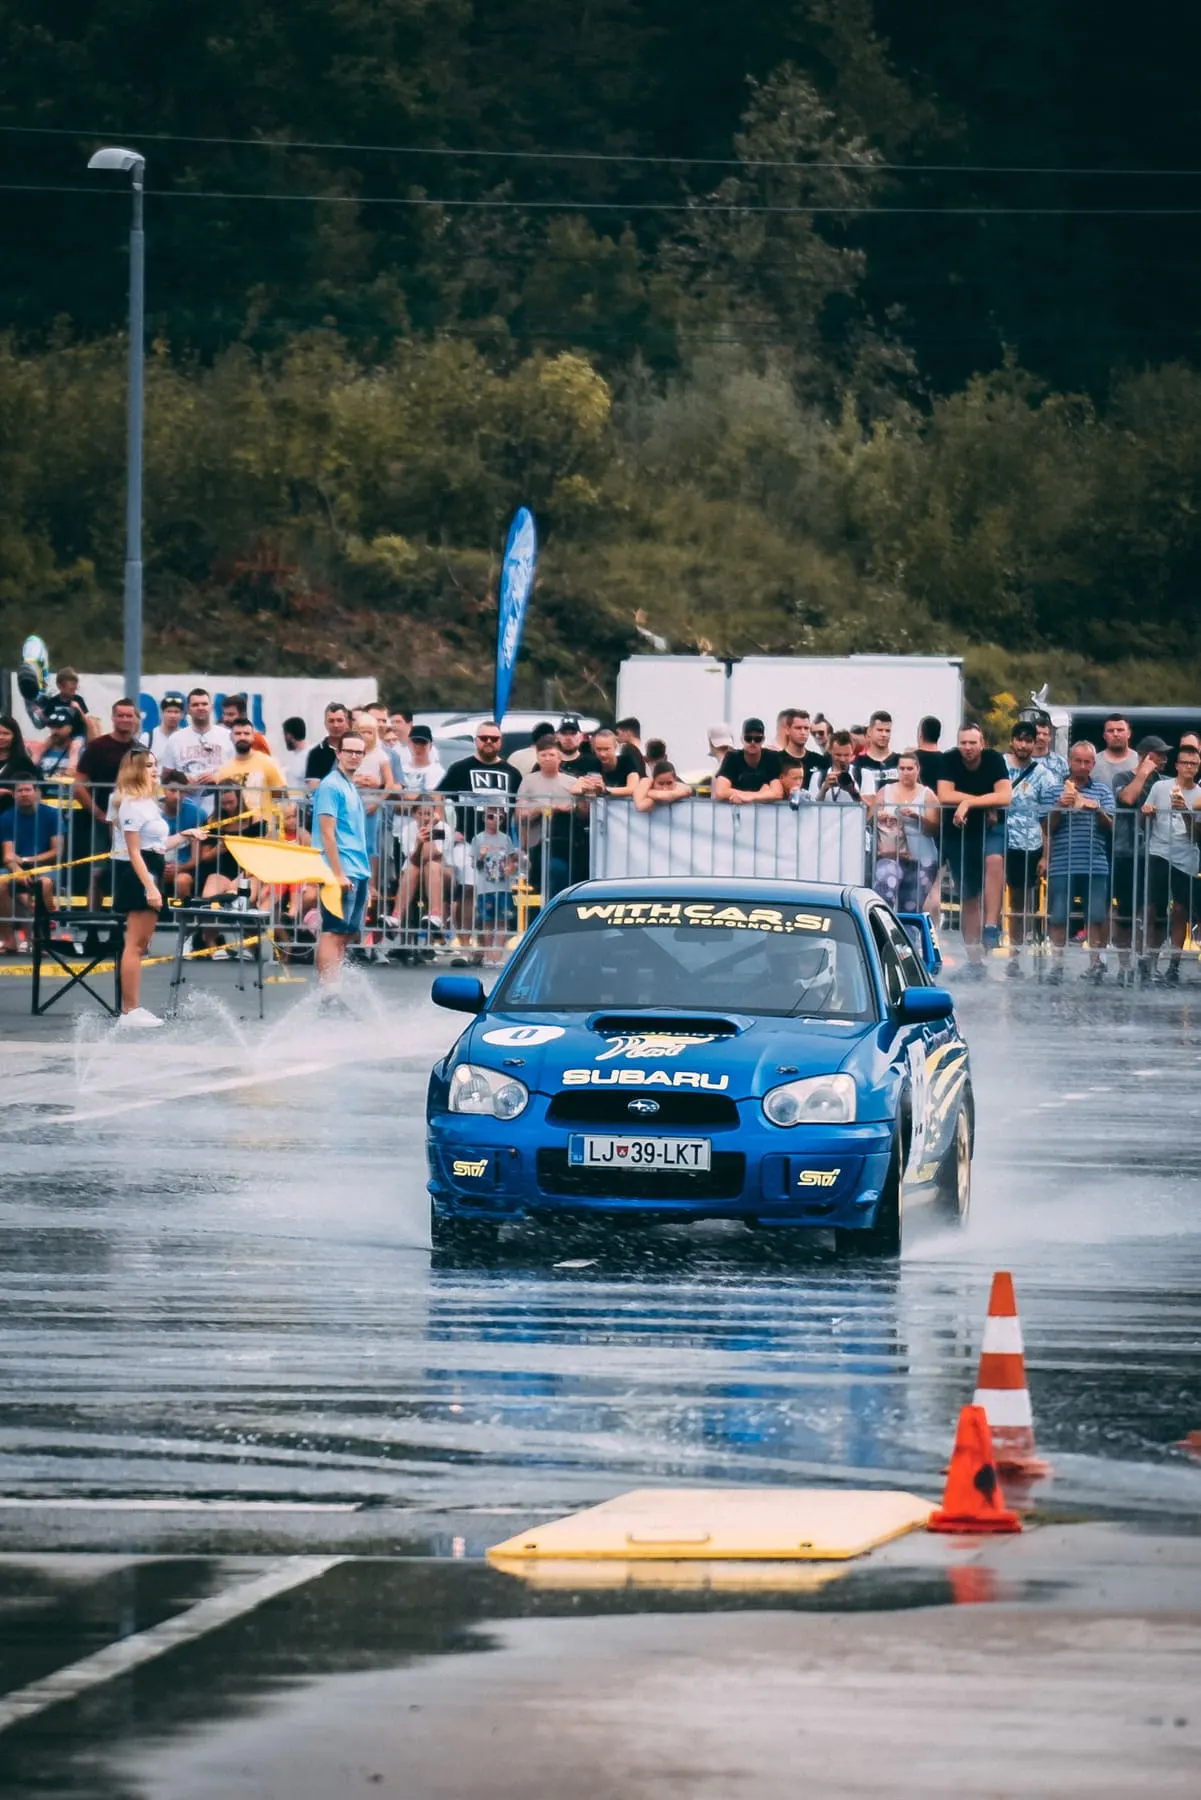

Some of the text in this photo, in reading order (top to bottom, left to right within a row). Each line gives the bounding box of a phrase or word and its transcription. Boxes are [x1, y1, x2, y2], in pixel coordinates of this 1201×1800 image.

[576, 903, 832, 932] WITHCAR.SI
[608, 917, 795, 933] IZBRANA POPOLNOST
[562, 1069, 729, 1090] SUBARU
[589, 1140, 703, 1165] LJ 39-LKT
